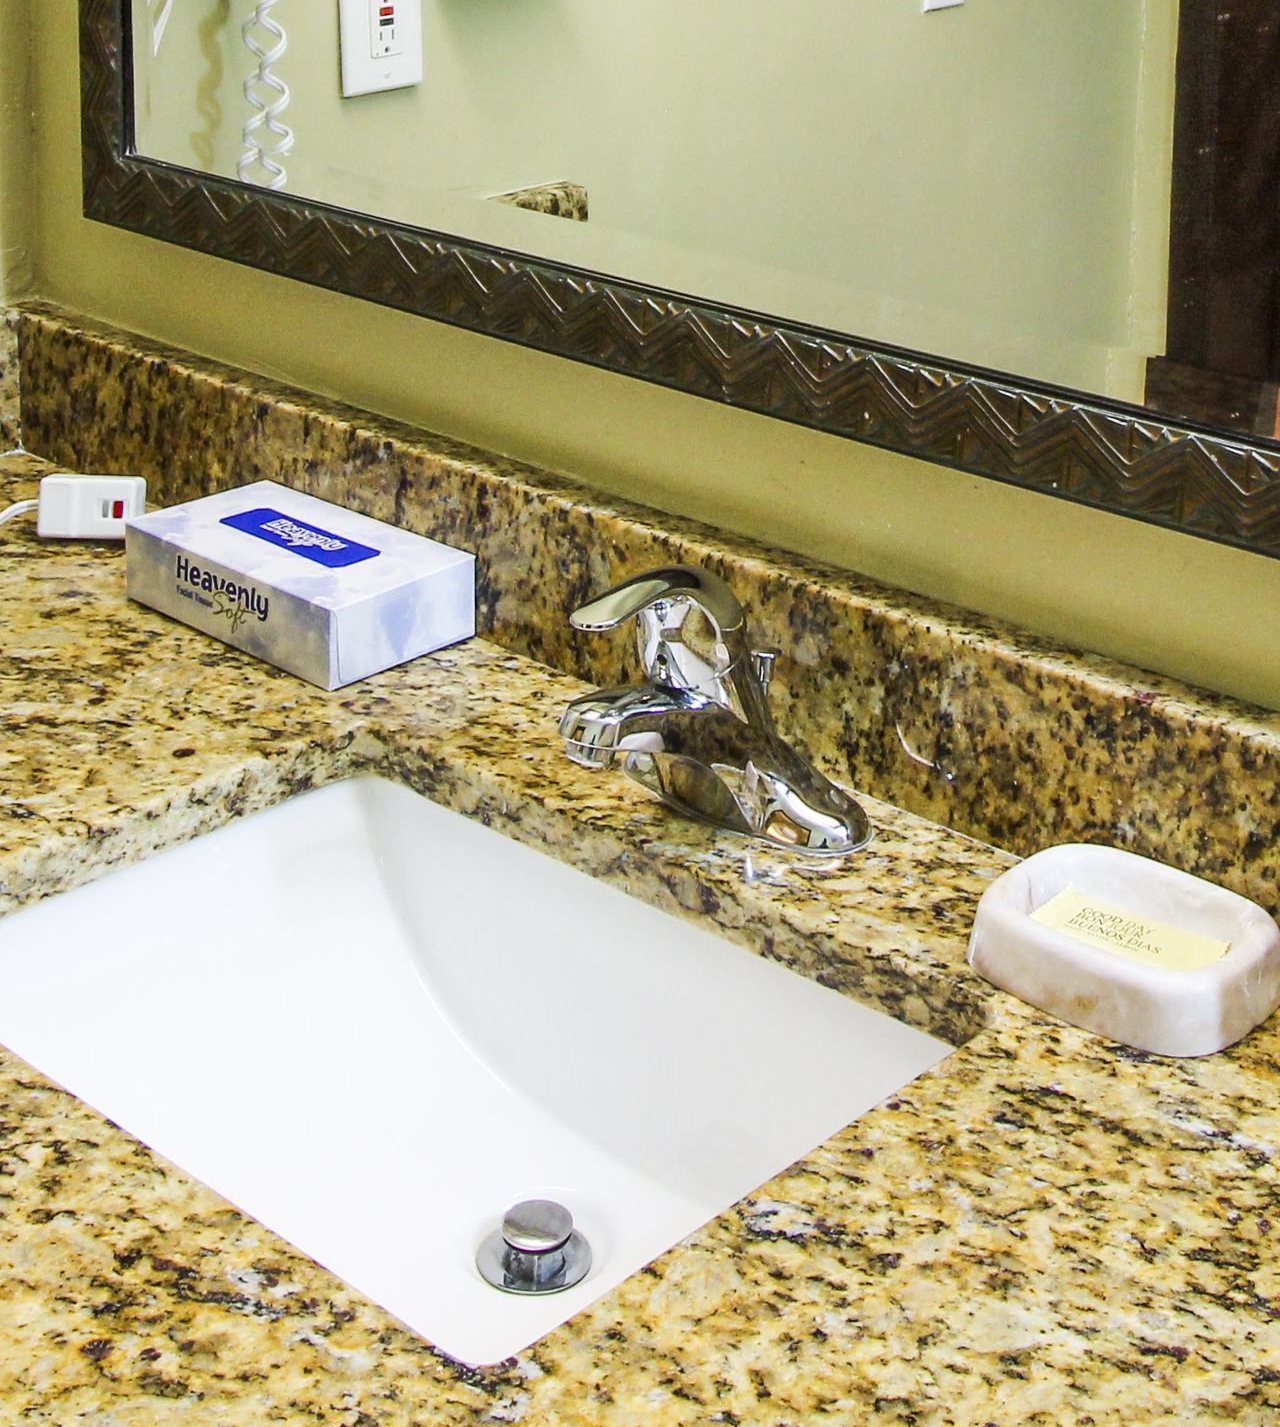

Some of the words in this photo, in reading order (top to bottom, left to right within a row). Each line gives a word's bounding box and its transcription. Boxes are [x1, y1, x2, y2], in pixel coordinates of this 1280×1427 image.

[176, 555, 269, 621] Heavenly
[213, 591, 256, 634] Soft
[1067, 917, 1124, 941] BUENOS
[1127, 937, 1162, 954] DIAS
[1081, 907, 1124, 924] GOOD
